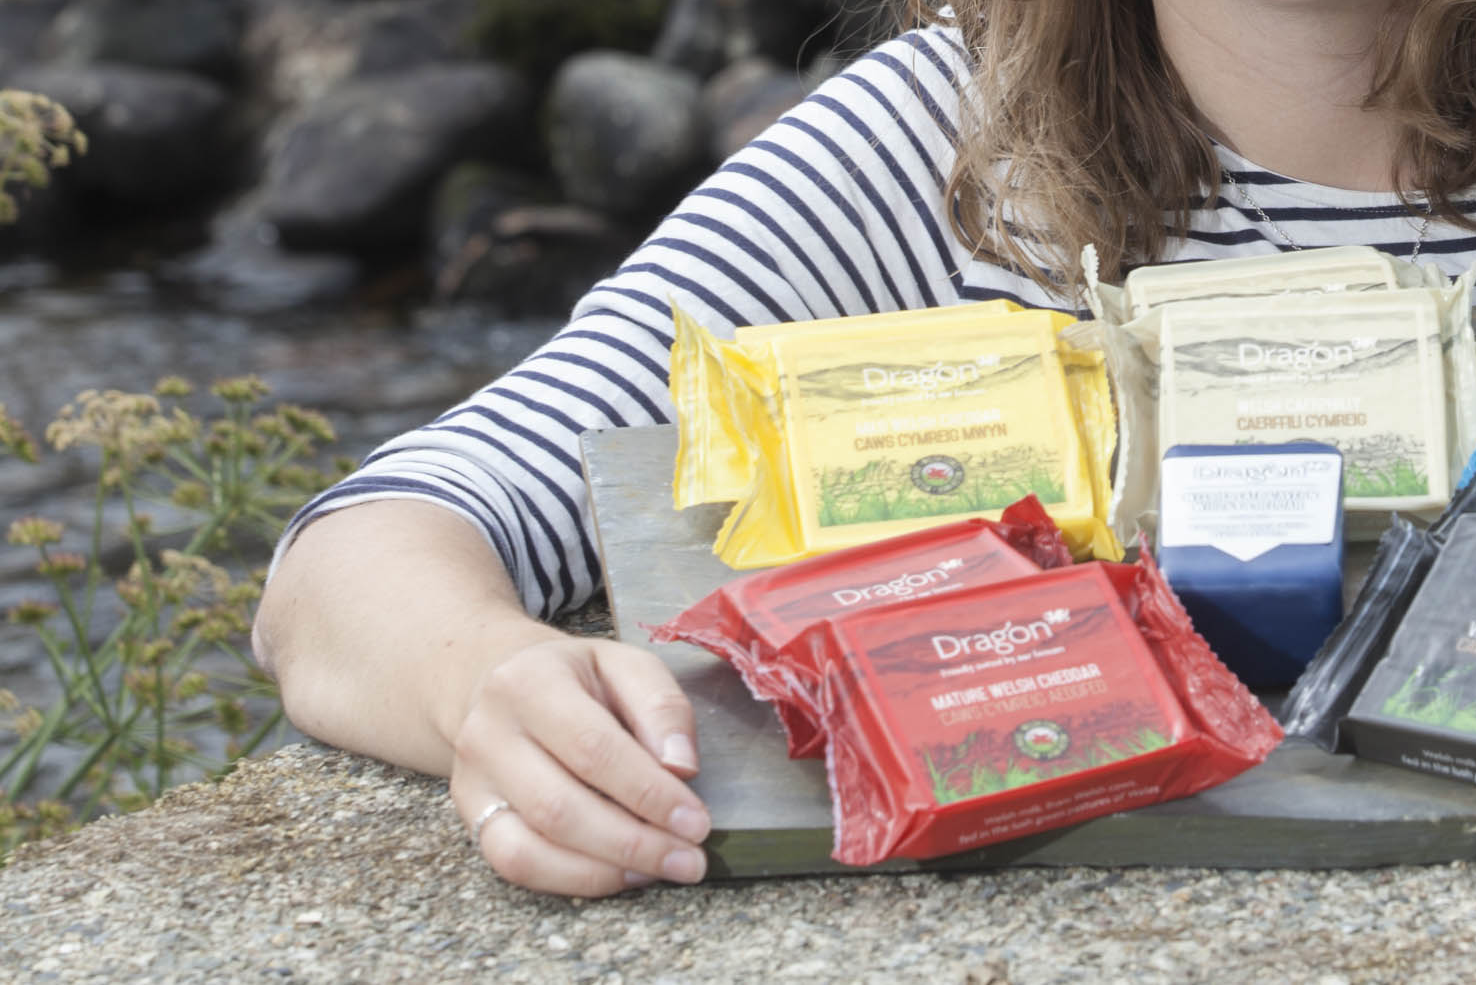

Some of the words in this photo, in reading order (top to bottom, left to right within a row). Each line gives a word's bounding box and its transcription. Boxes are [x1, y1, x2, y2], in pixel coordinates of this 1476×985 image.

[1238, 341, 1353, 370] Dragon
[863, 360, 979, 391] Dragon
[1304, 411, 1368, 429] CYMREIG
[854, 433, 895, 452] CAWS
[897, 428, 960, 447] CYMREIG
[961, 422, 1008, 441] MWYN
[832, 568, 950, 606] Dragon
[931, 619, 1055, 660] Dragon
[930, 687, 988, 712] MATURE
[988, 676, 1037, 699] WELSH
[1036, 663, 1103, 688] CHEDDAR
